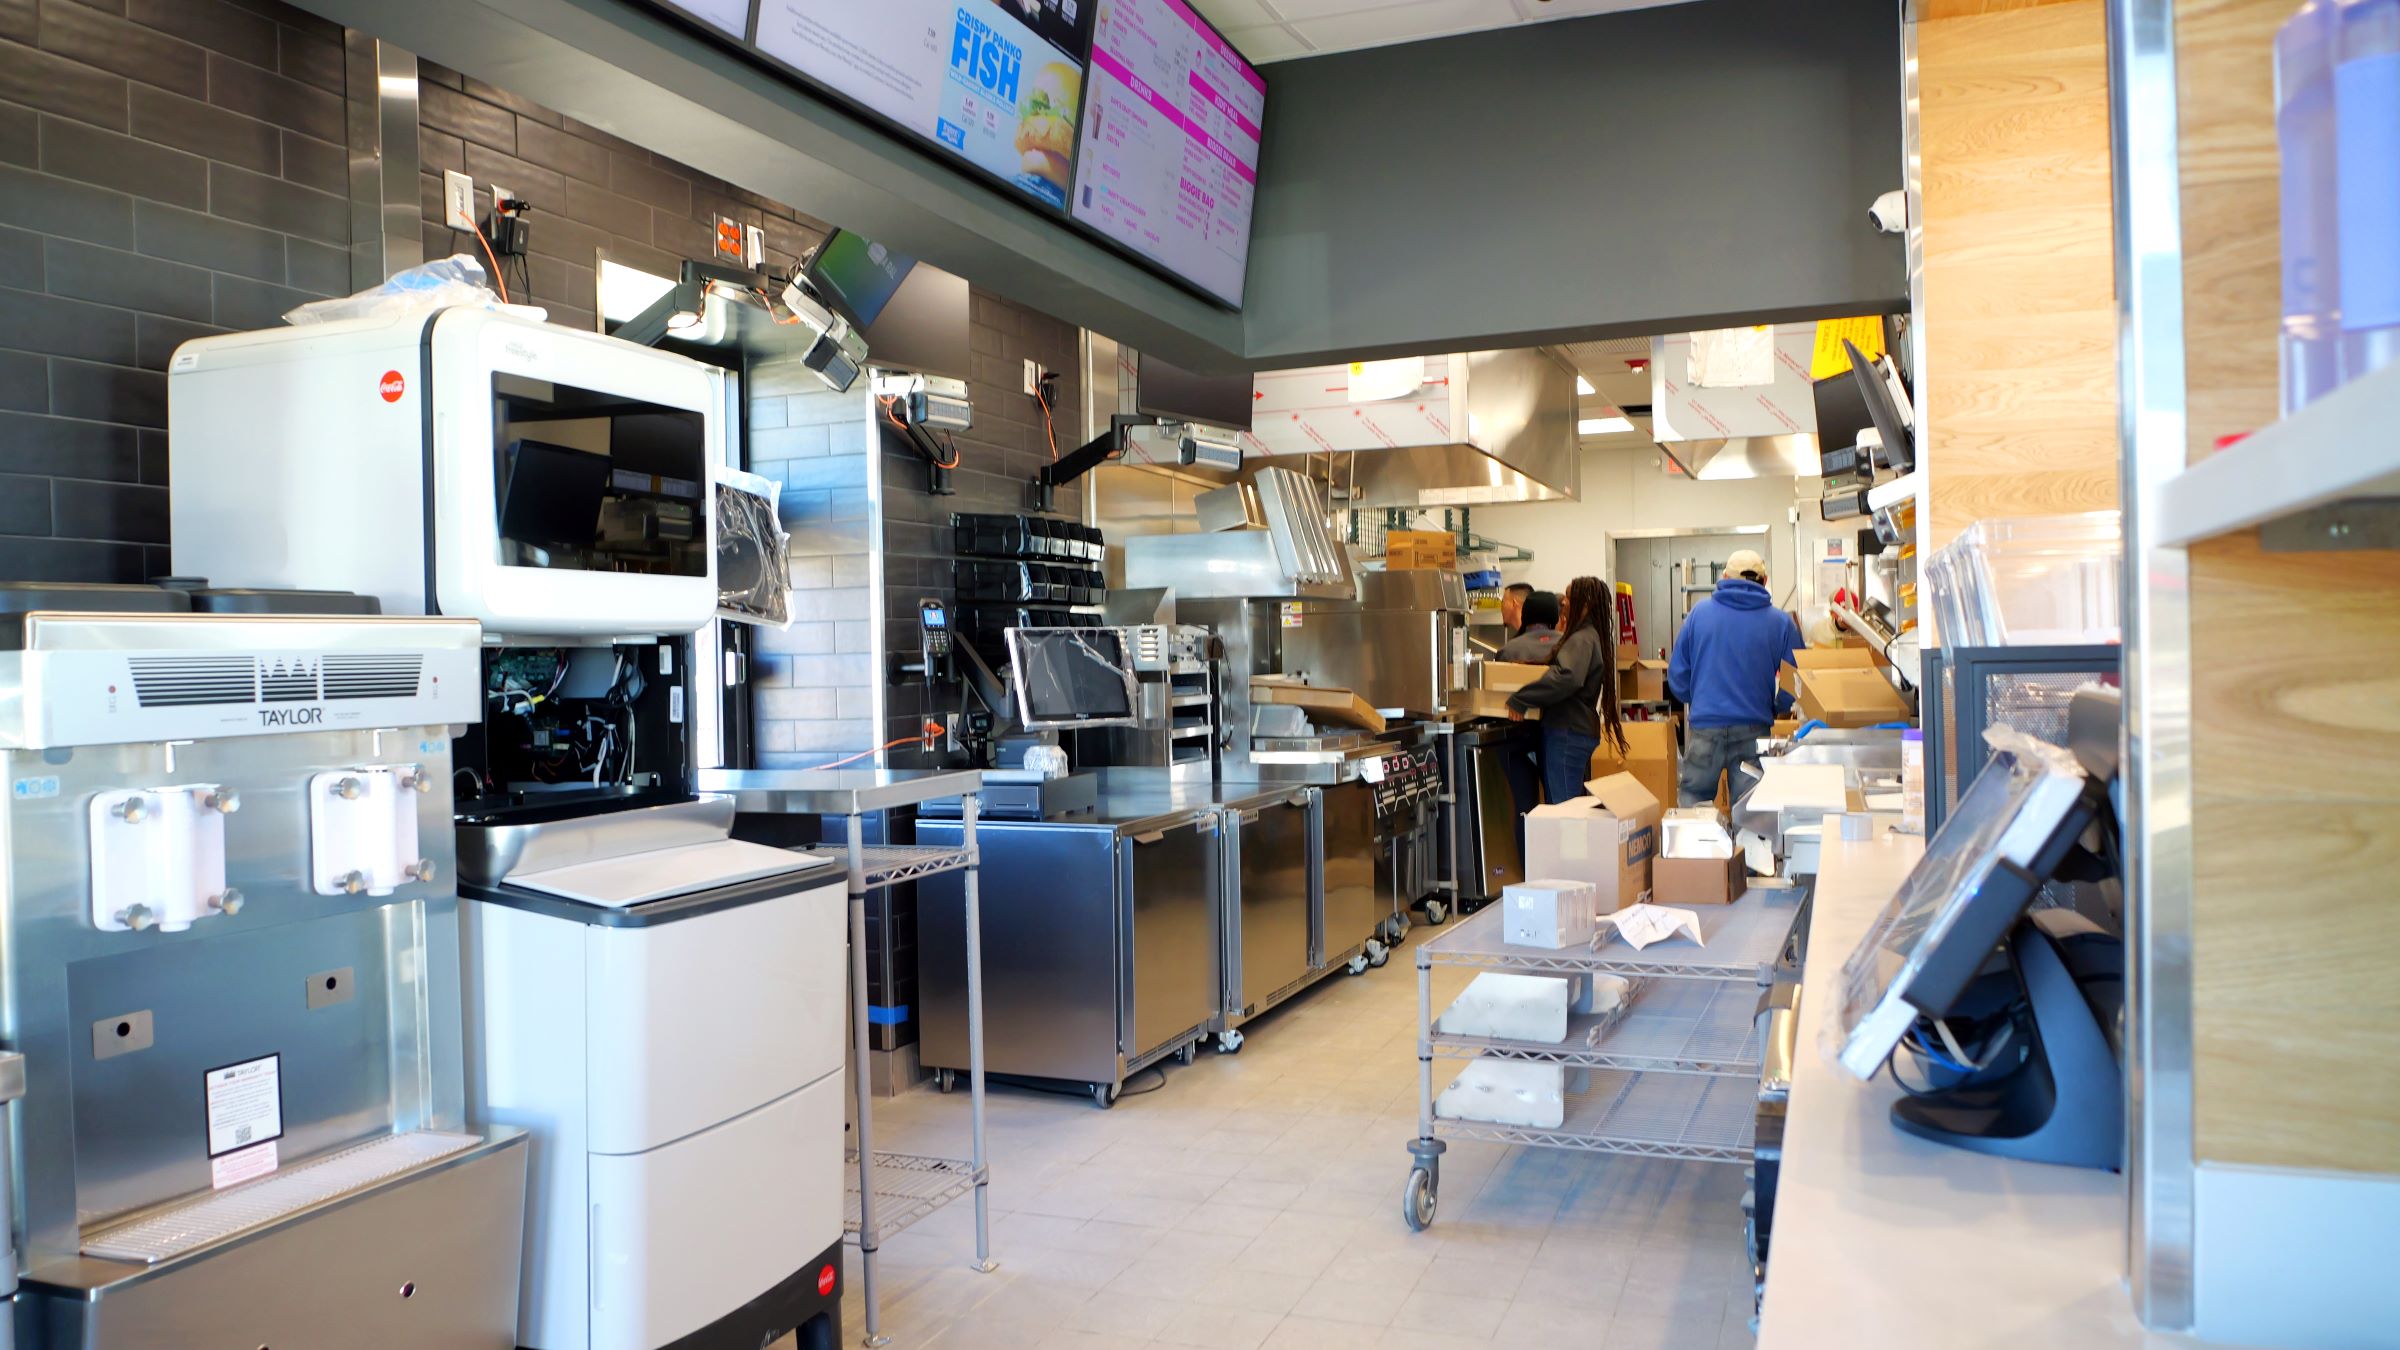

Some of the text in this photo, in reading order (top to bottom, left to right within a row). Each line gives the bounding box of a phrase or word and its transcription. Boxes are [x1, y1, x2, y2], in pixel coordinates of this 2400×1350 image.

[957, 7, 992, 40] CRISPY
[992, 31, 1022, 60] PANKO
[951, 22, 1020, 105] FISH
[1220, 45, 1242, 73] DESSERTS
[1130, 75, 1152, 101] DRINKS
[1227, 105, 1239, 123] MEAL
[1207, 136, 1223, 157] BIGGIE
[1179, 175, 1201, 202] BIGGIE
[1201, 189, 1215, 209] BAG
[258, 707, 323, 727] TAYLOR
[1628, 832, 1651, 859] NEMCO
